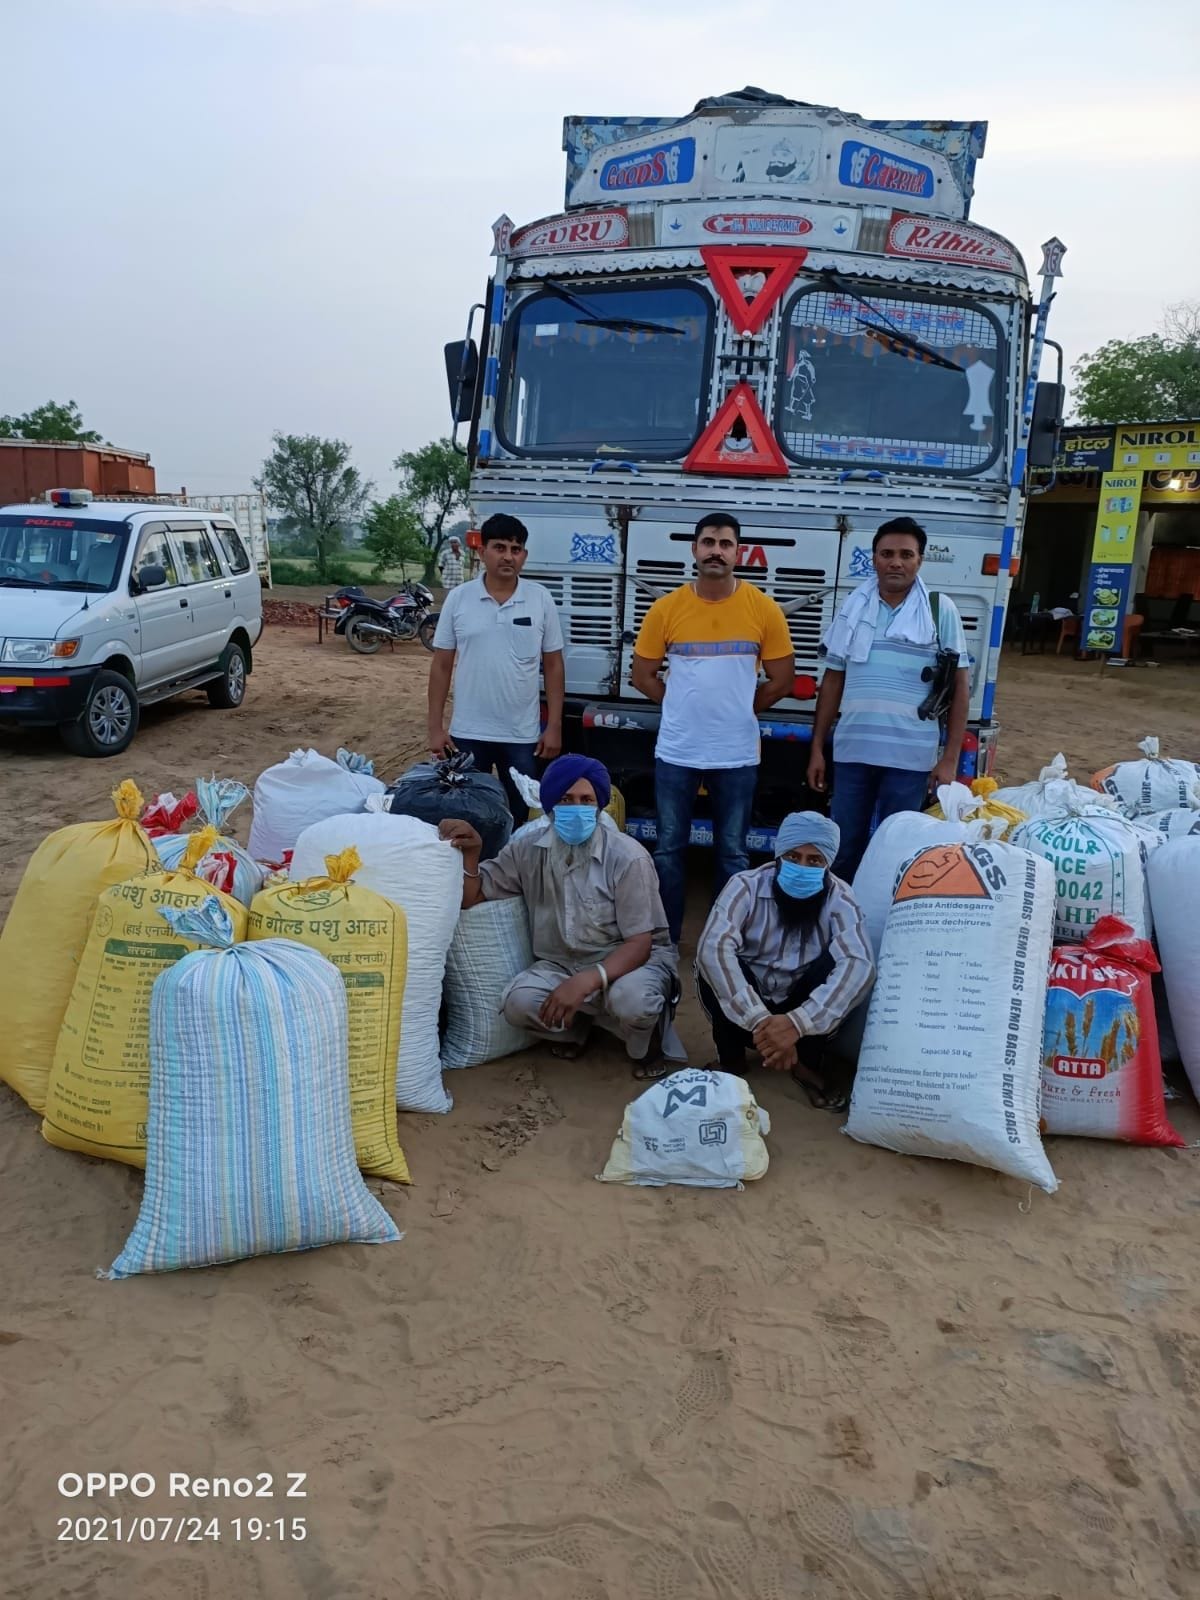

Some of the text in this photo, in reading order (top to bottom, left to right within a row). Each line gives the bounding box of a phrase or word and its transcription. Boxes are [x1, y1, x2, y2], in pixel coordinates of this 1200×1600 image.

[607, 151, 666, 188] GOODS
[863, 153, 926, 193] CARRIER
[530, 219, 612, 246] GURU
[1065, 435, 1112, 451] होटल
[25, 518, 75, 528] POLICE
[737, 545, 768, 567] TA
[122, 884, 147, 909] पशु
[151, 888, 200, 908] आहार
[1021, 859, 1036, 921] DEMO BAGS
[934, 901, 994, 911] Antidesgarre
[266, 910, 304, 935] गोल्ड
[309, 919, 341, 942] पशु
[345, 919, 388, 937] आहार
[1012, 926, 1031, 991] DEMO BAGS
[1004, 998, 1023, 1066] DEMO BAGS
[1058, 1058, 1101, 1075] ATTA
[873, 1087, 941, 1101] www.demobags.com
[1072, 1085, 1083, 1096] &
[1089, 1085, 1121, 1098] Fresh
[1002, 1073, 1021, 1144] DEMO BAGS
